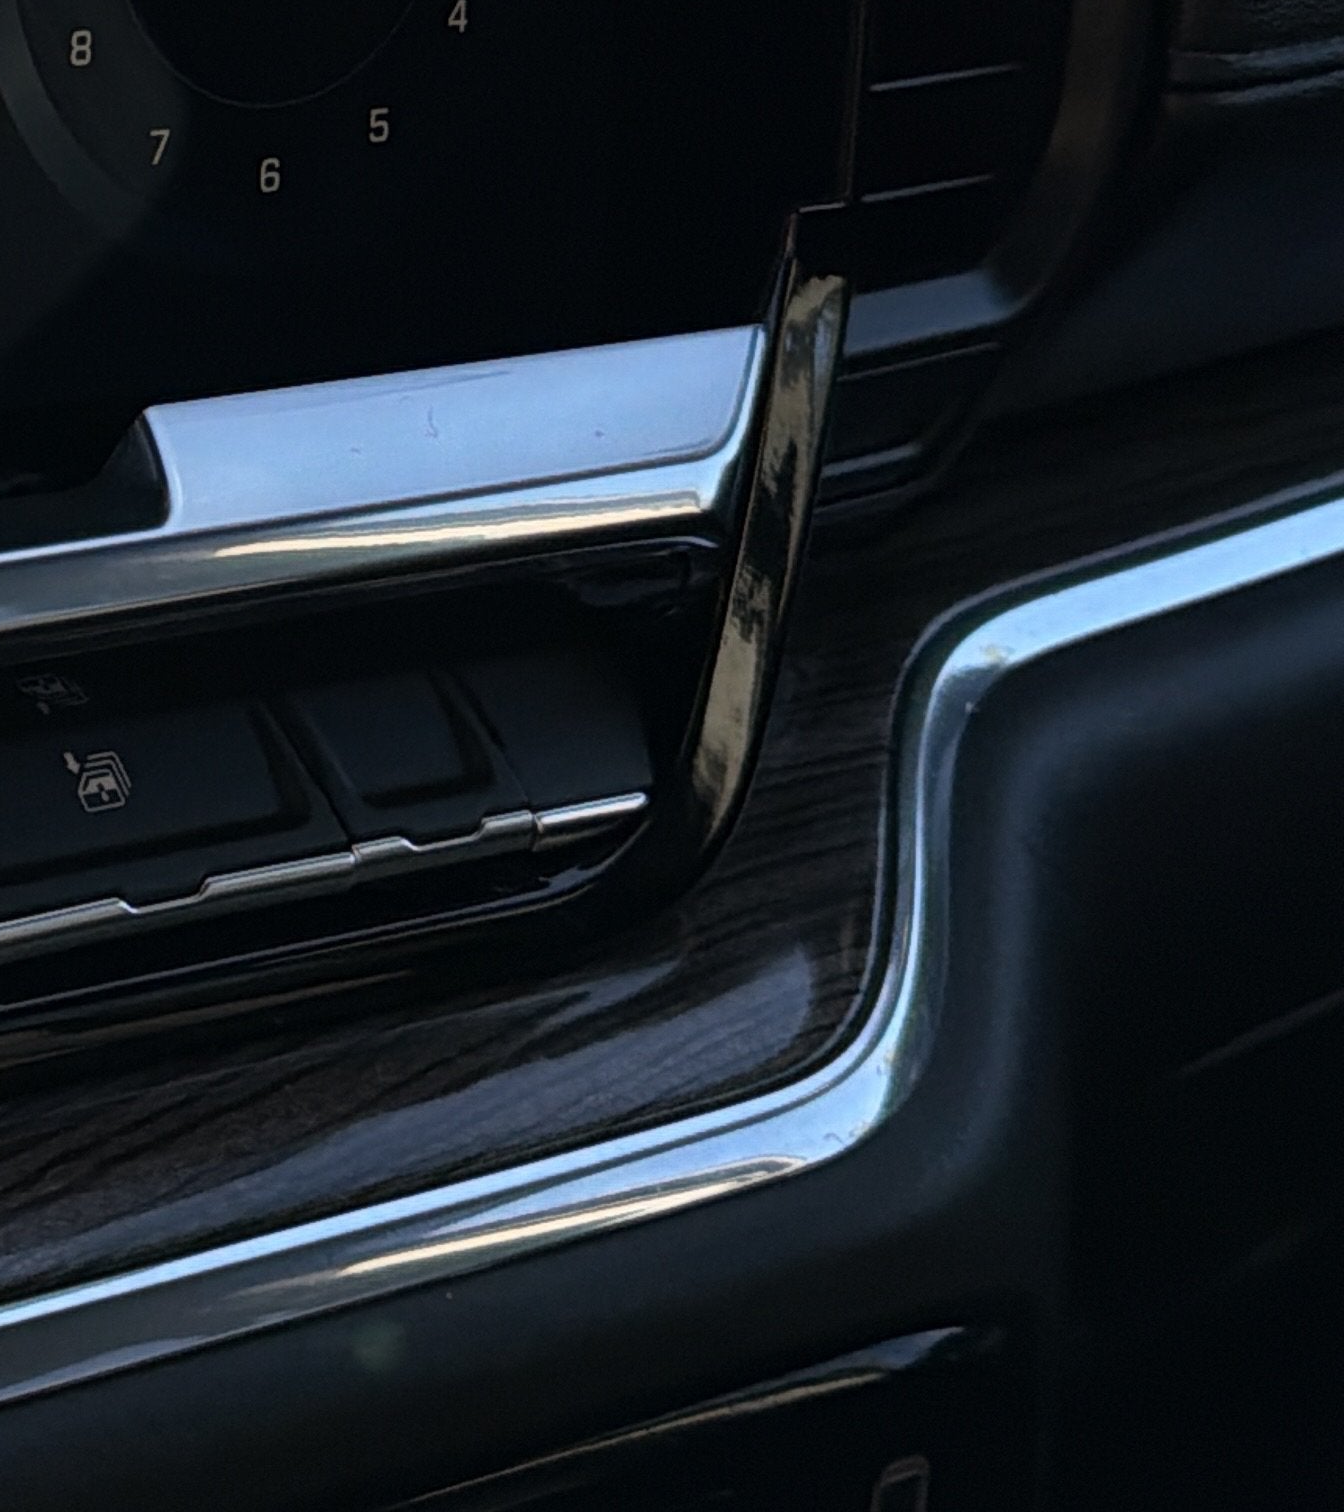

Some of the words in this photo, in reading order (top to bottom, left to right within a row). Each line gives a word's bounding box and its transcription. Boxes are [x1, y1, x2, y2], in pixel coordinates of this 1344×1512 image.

[70, 30, 92, 66] 8
[369, 107, 389, 143] 5
[149, 129, 170, 165] 7
[260, 157, 281, 193] 6
